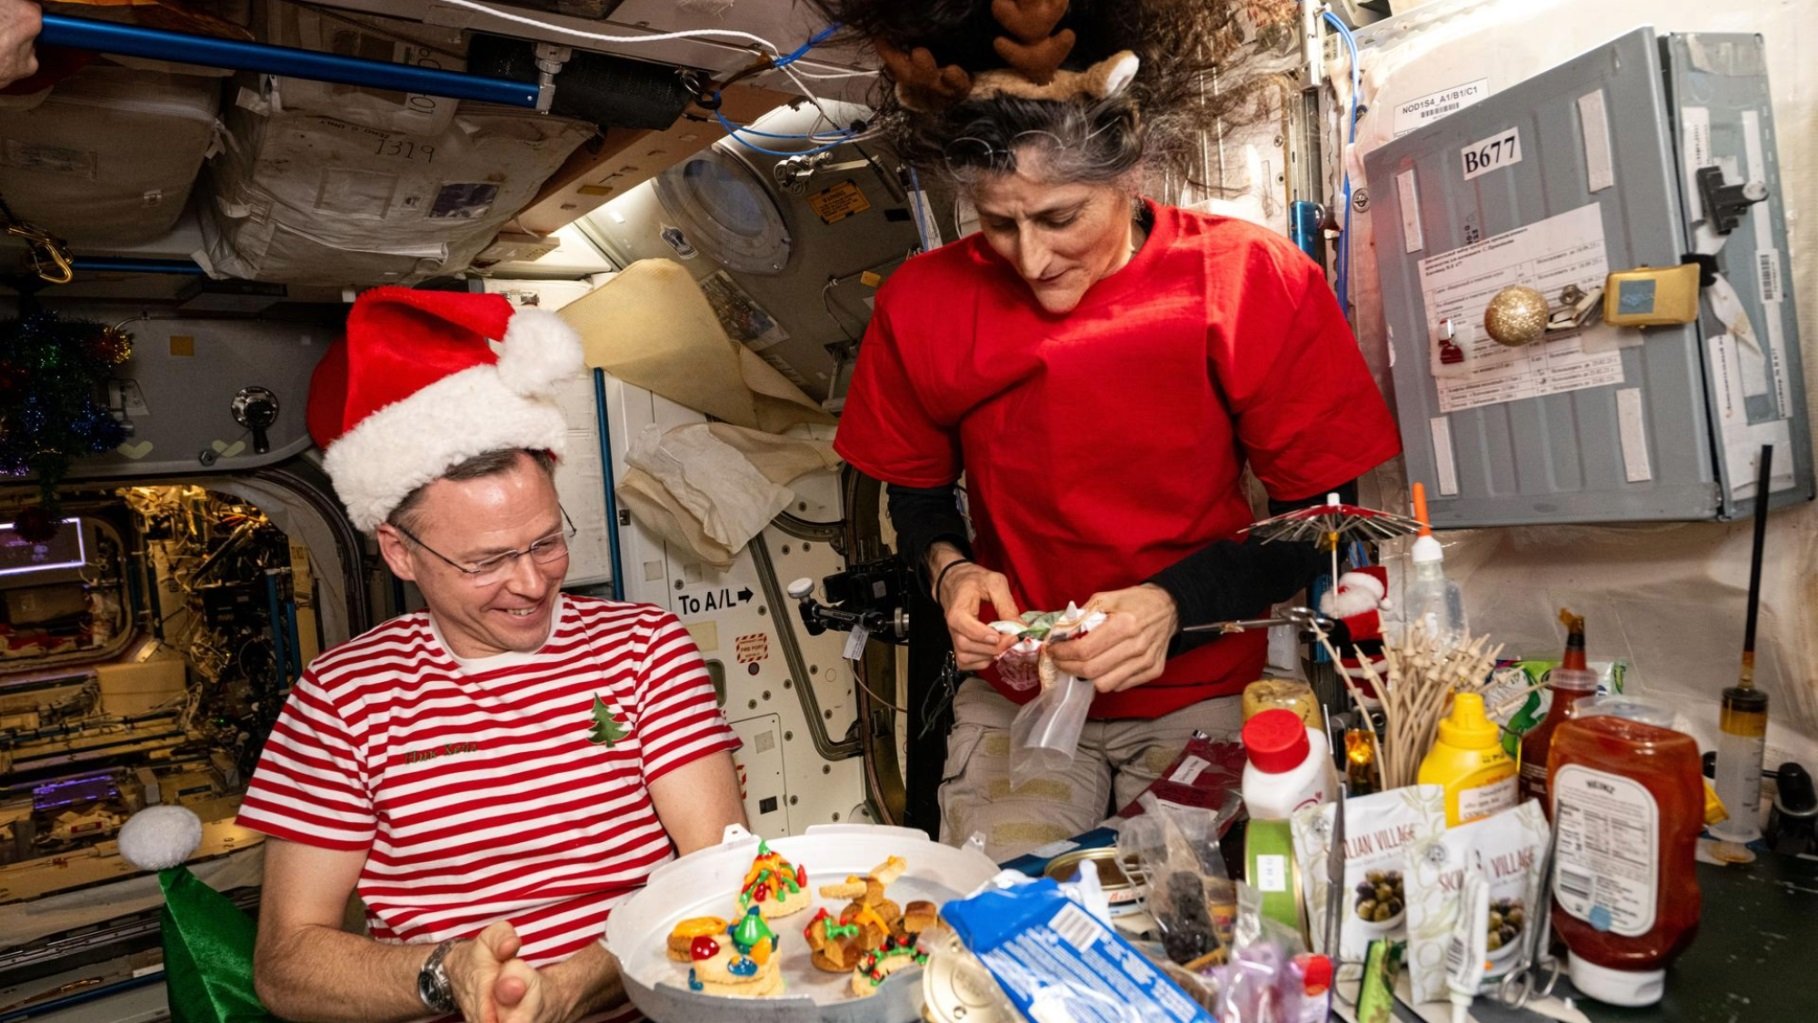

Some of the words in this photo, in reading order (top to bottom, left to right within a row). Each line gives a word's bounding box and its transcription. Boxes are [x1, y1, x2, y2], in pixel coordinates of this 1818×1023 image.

[1464, 135, 1515, 174] B677
[678, 594, 701, 615] To
[705, 588, 737, 612] A/L
